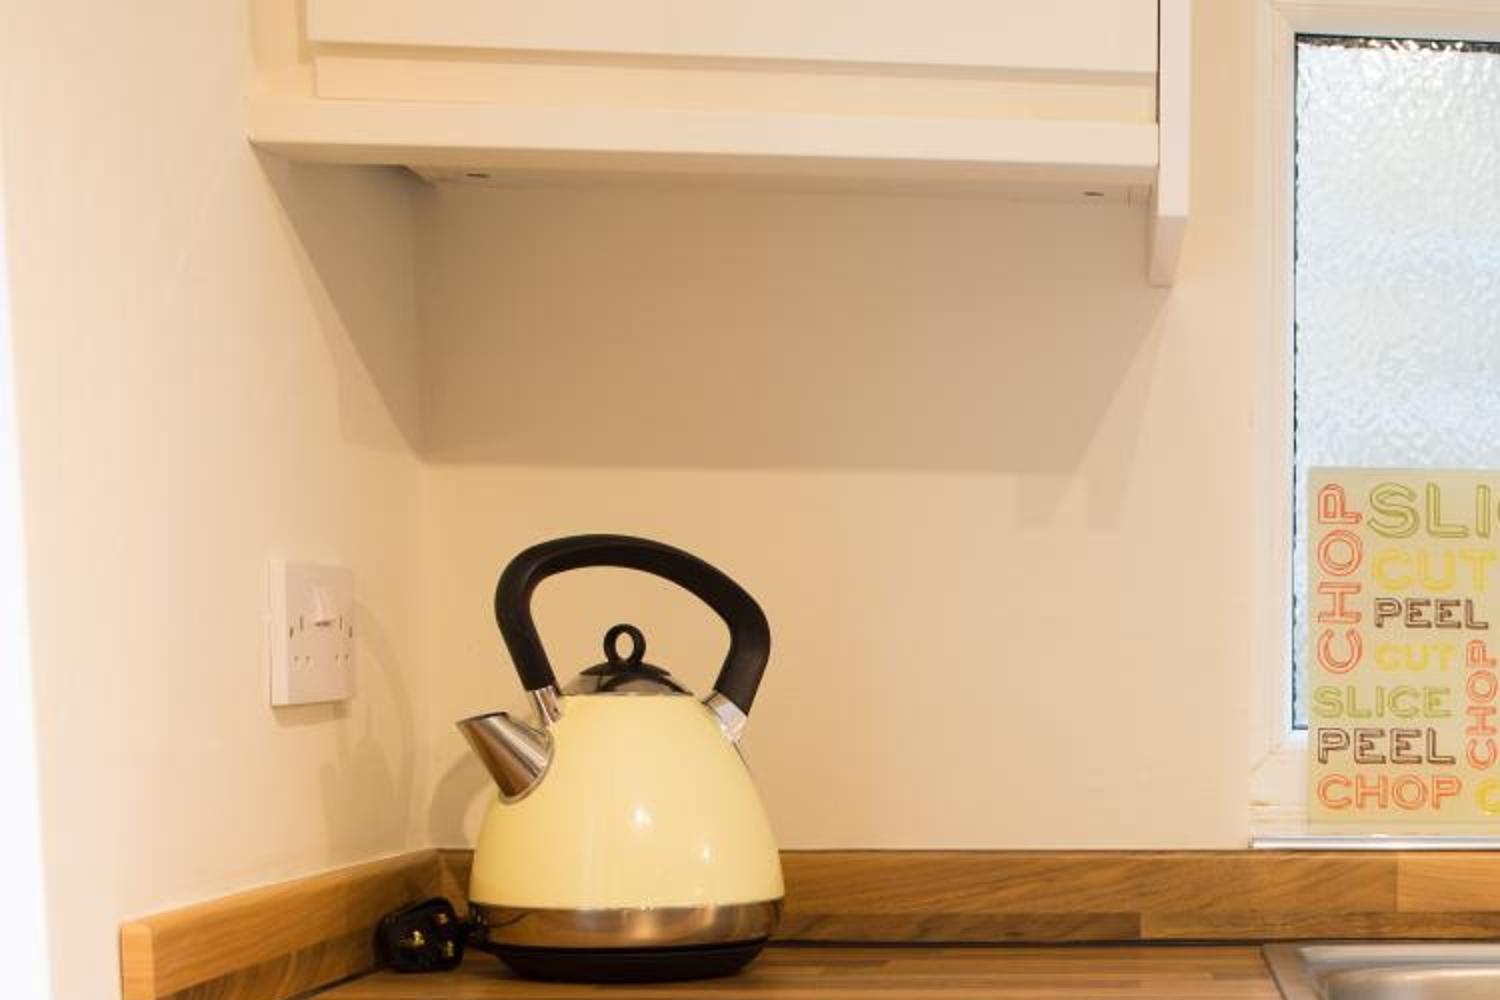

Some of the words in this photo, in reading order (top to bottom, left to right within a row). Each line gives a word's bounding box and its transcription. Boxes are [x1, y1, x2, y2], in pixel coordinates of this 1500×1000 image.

[1317, 483, 1363, 674] CHOP
[1371, 549, 1498, 592] CUT
[1373, 597, 1489, 630] PEEL
[1374, 642, 1455, 672] CUT
[1312, 685, 1453, 720] SLICE
[1465, 639, 1499, 770] CHOP
[1316, 727, 1456, 766] PEEL
[1316, 775, 1463, 811] CHOP
